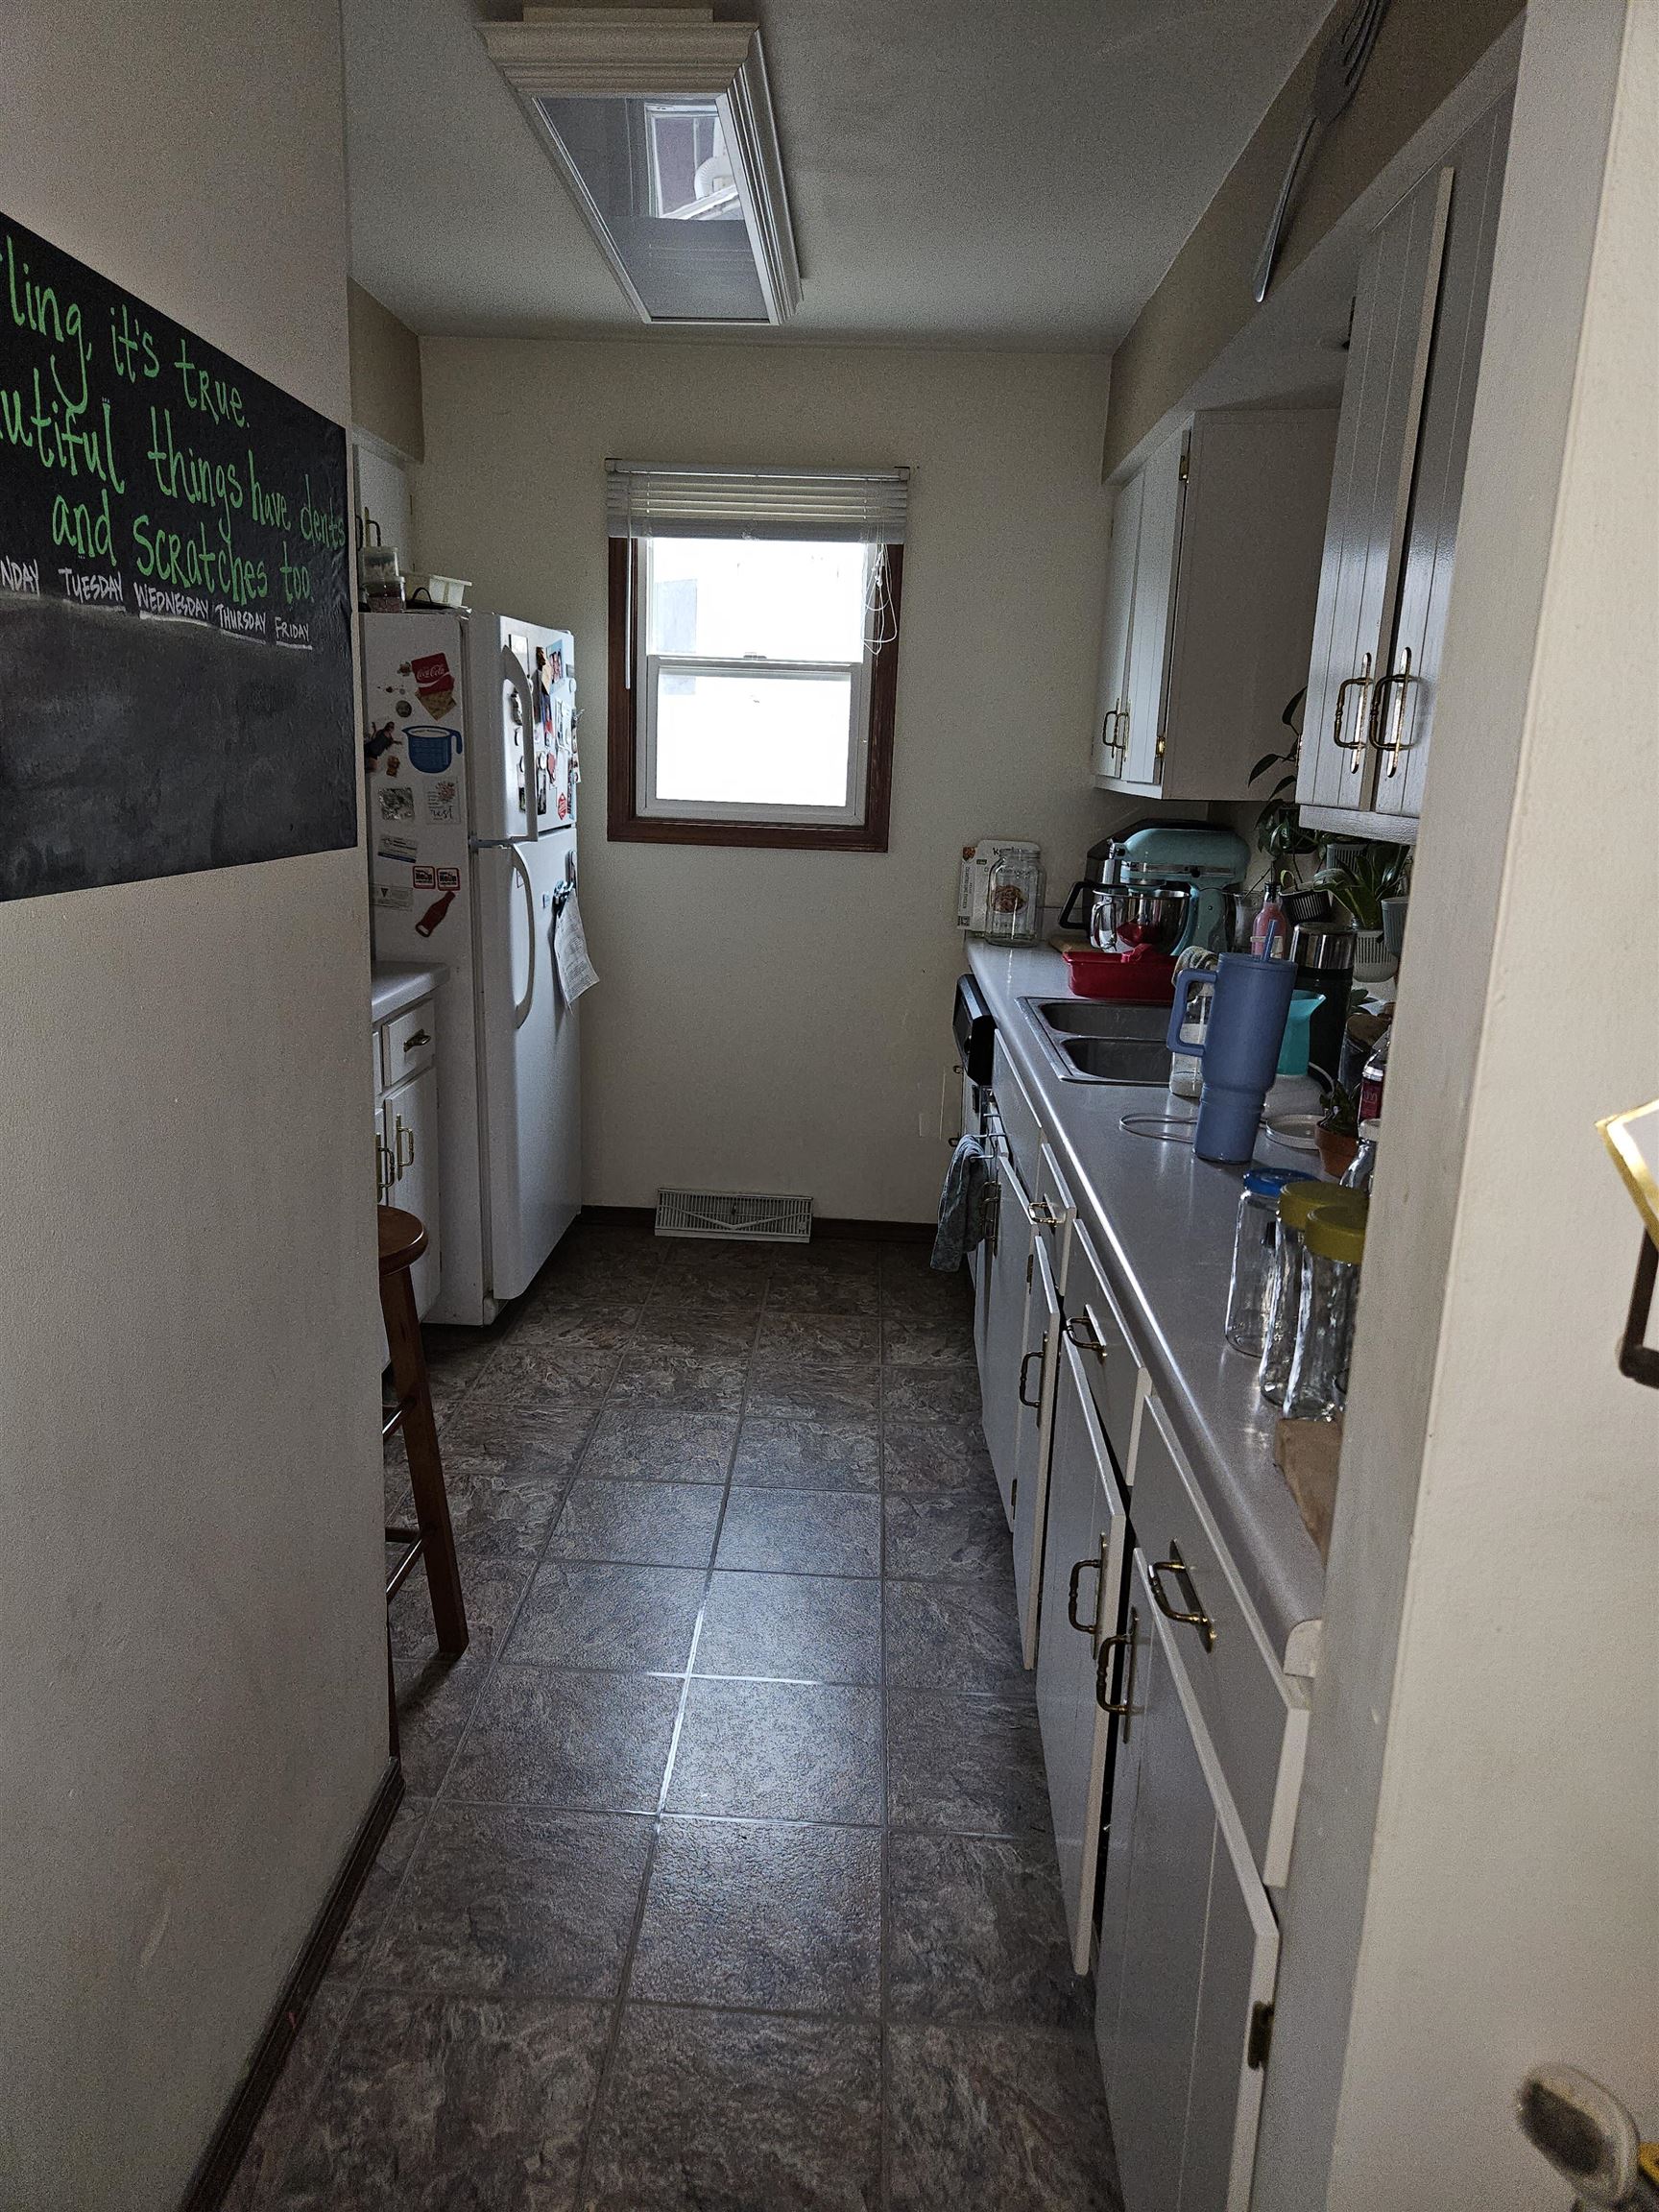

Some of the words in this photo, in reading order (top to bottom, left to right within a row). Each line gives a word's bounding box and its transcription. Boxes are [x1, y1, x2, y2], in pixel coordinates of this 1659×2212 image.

[110, 303, 160, 384] it's
[0, 368, 125, 494] utiful
[147, 406, 244, 544] things
[248, 448, 291, 531] have
[301, 473, 347, 550] dents
[52, 488, 117, 566] and
[58, 566, 124, 604] TUESDAY
[132, 581, 209, 620] WEDNESDAY
[215, 602, 267, 635] THURSDAY
[275, 615, 310, 642] FRIDAY
